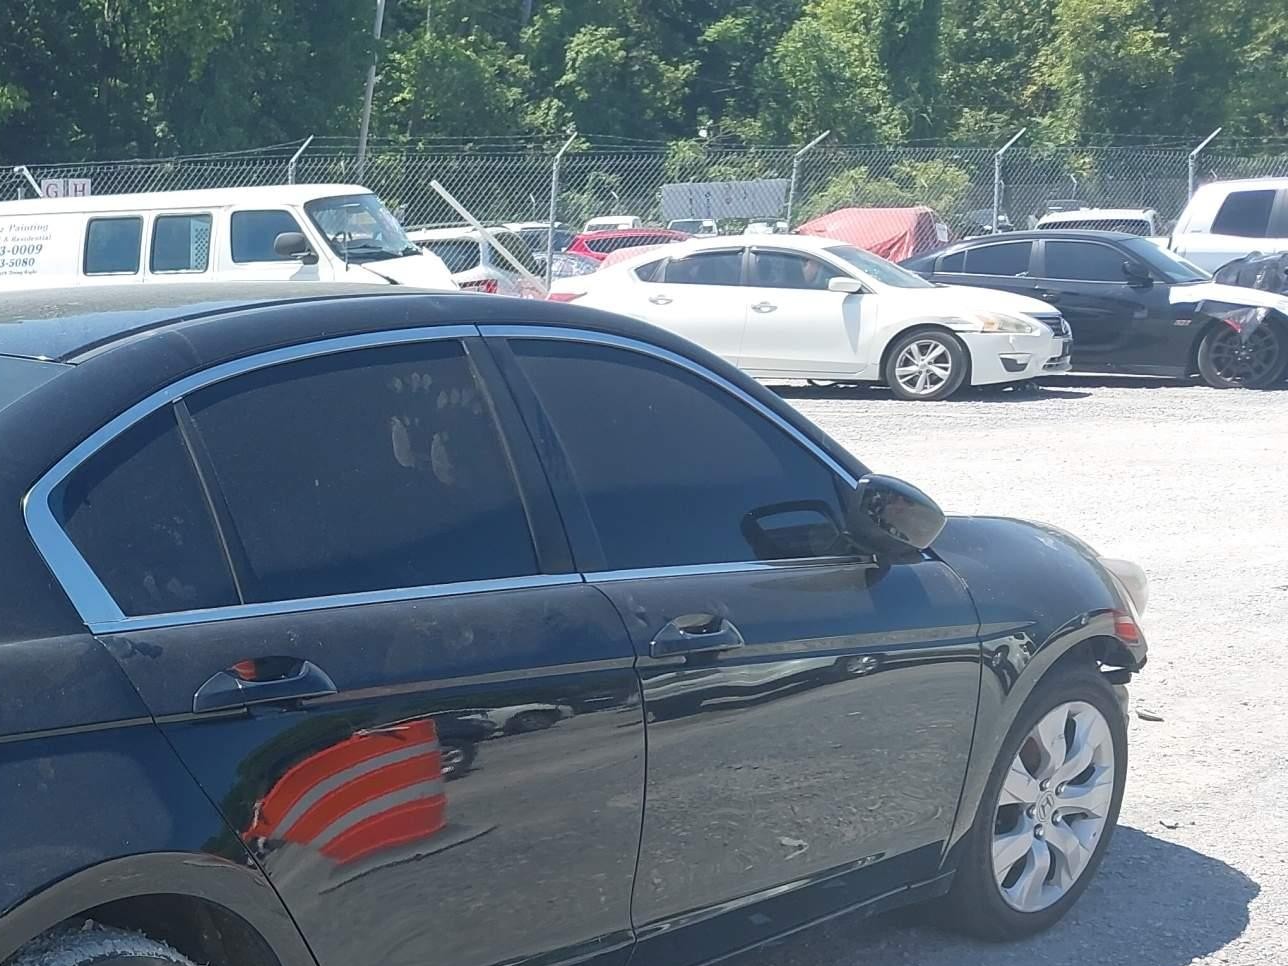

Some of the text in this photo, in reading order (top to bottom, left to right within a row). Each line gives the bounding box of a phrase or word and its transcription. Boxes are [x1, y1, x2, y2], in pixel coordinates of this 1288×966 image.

[46, 183, 59, 198] G
[73, 182, 86, 197] H
[9, 223, 49, 233] Painting
